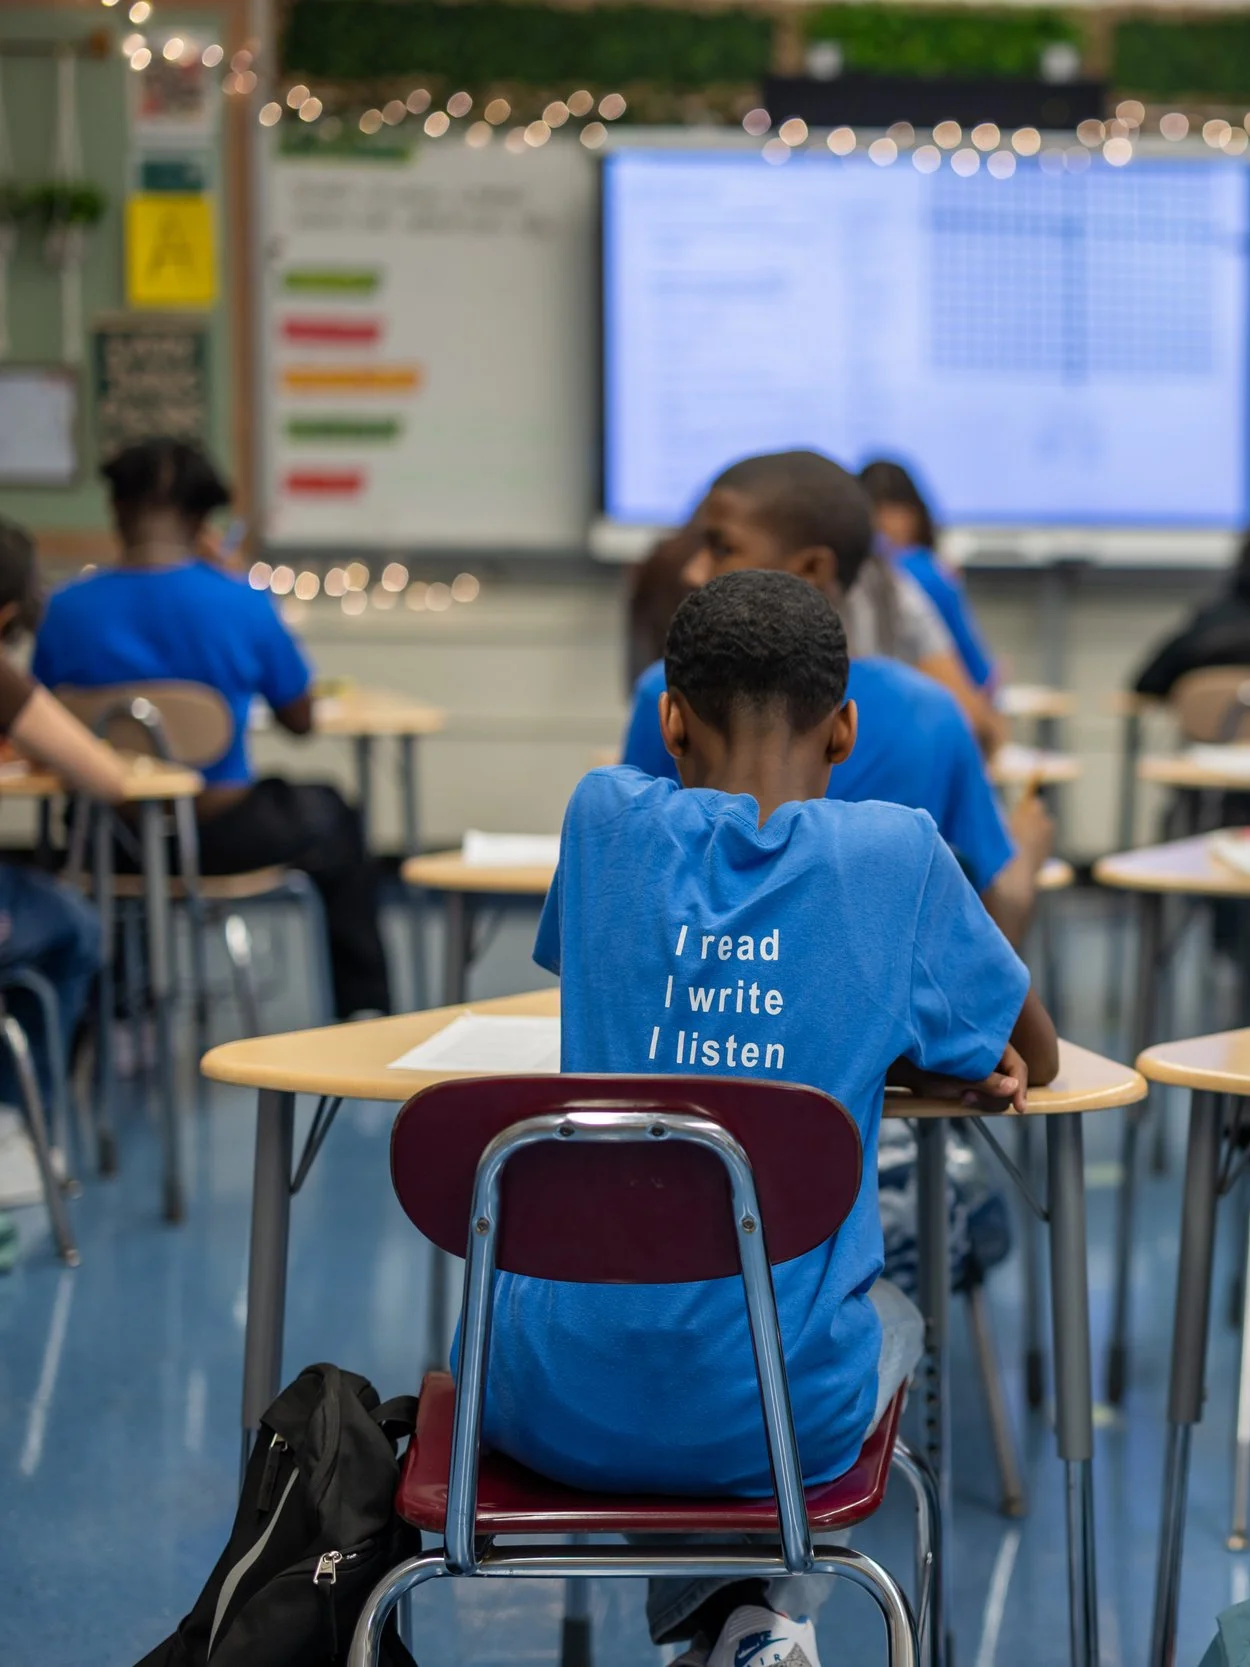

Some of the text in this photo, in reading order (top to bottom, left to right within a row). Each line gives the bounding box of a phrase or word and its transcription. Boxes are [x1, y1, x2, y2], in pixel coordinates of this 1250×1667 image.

[675, 925, 779, 961] I read
[664, 975, 784, 1015] I write
[649, 1026, 785, 1069] I listen
